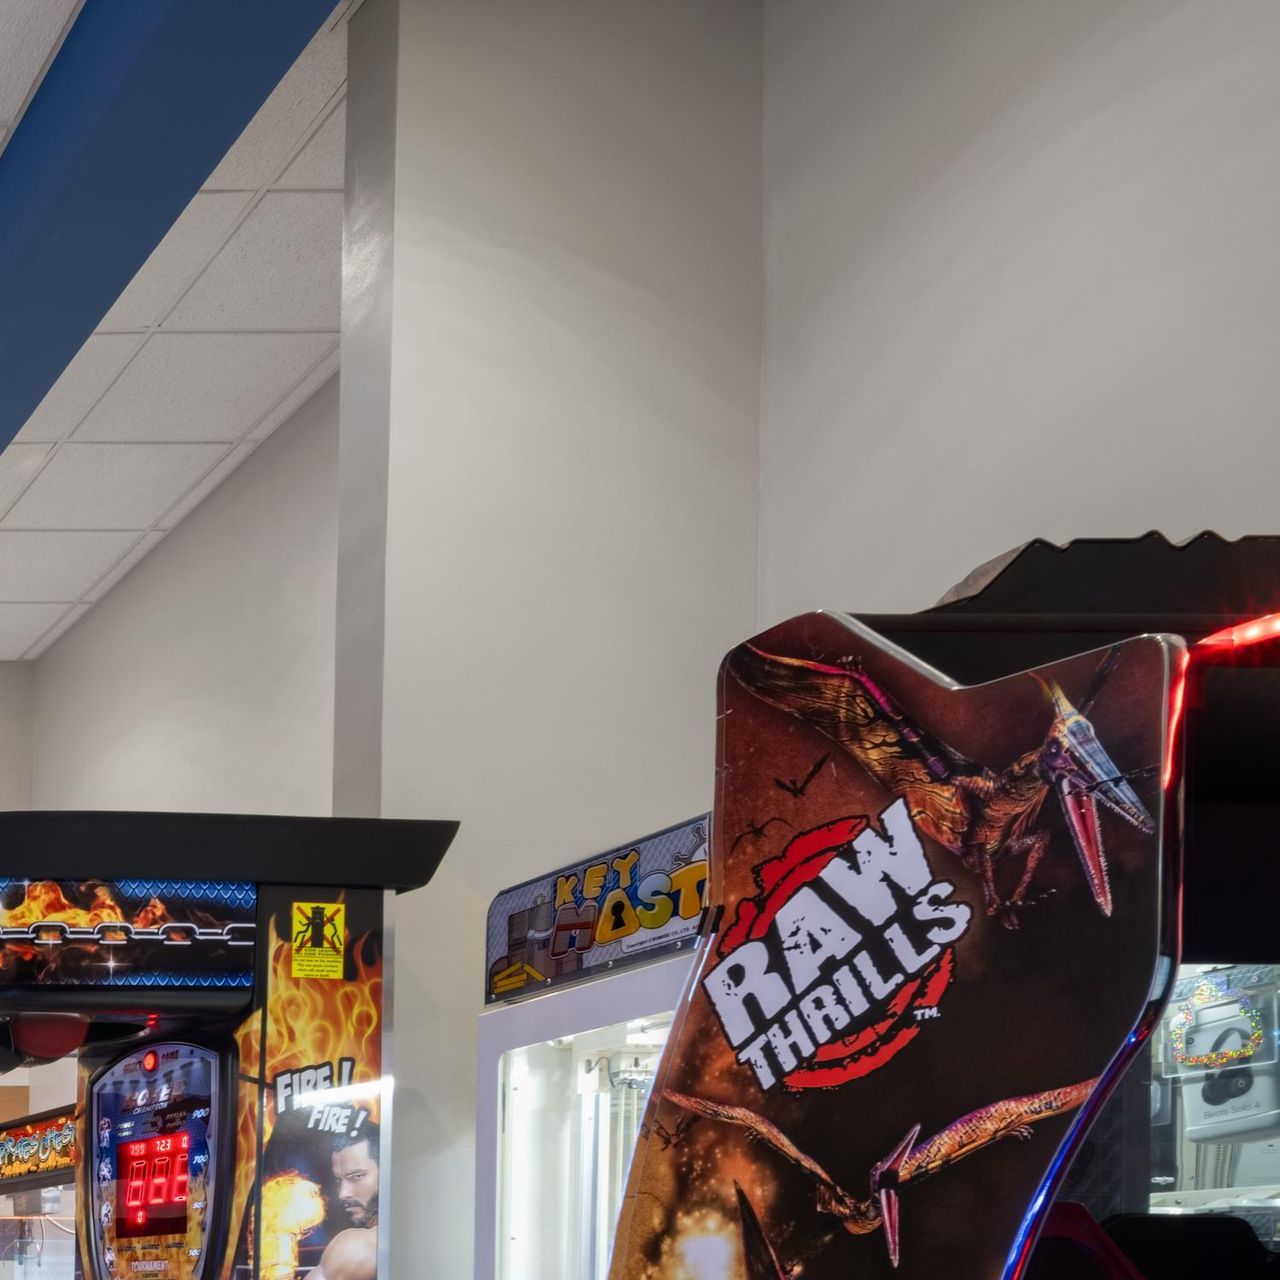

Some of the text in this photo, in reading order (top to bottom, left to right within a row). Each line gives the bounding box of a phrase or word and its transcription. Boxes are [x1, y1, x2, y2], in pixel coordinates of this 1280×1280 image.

[555, 850, 639, 909] KEY
[702, 798, 933, 1047] RAW
[738, 882, 971, 1090] THRILLS
[277, 1065, 331, 1113] FIRE
[192, 1108, 209, 1119] 900
[308, 1105, 351, 1133] FIRE
[1204, 1102, 1261, 1120] Beats Solo 4
[193, 1154, 209, 1165] 700
[131, 1261, 169, 1271] TOURNAMENT
